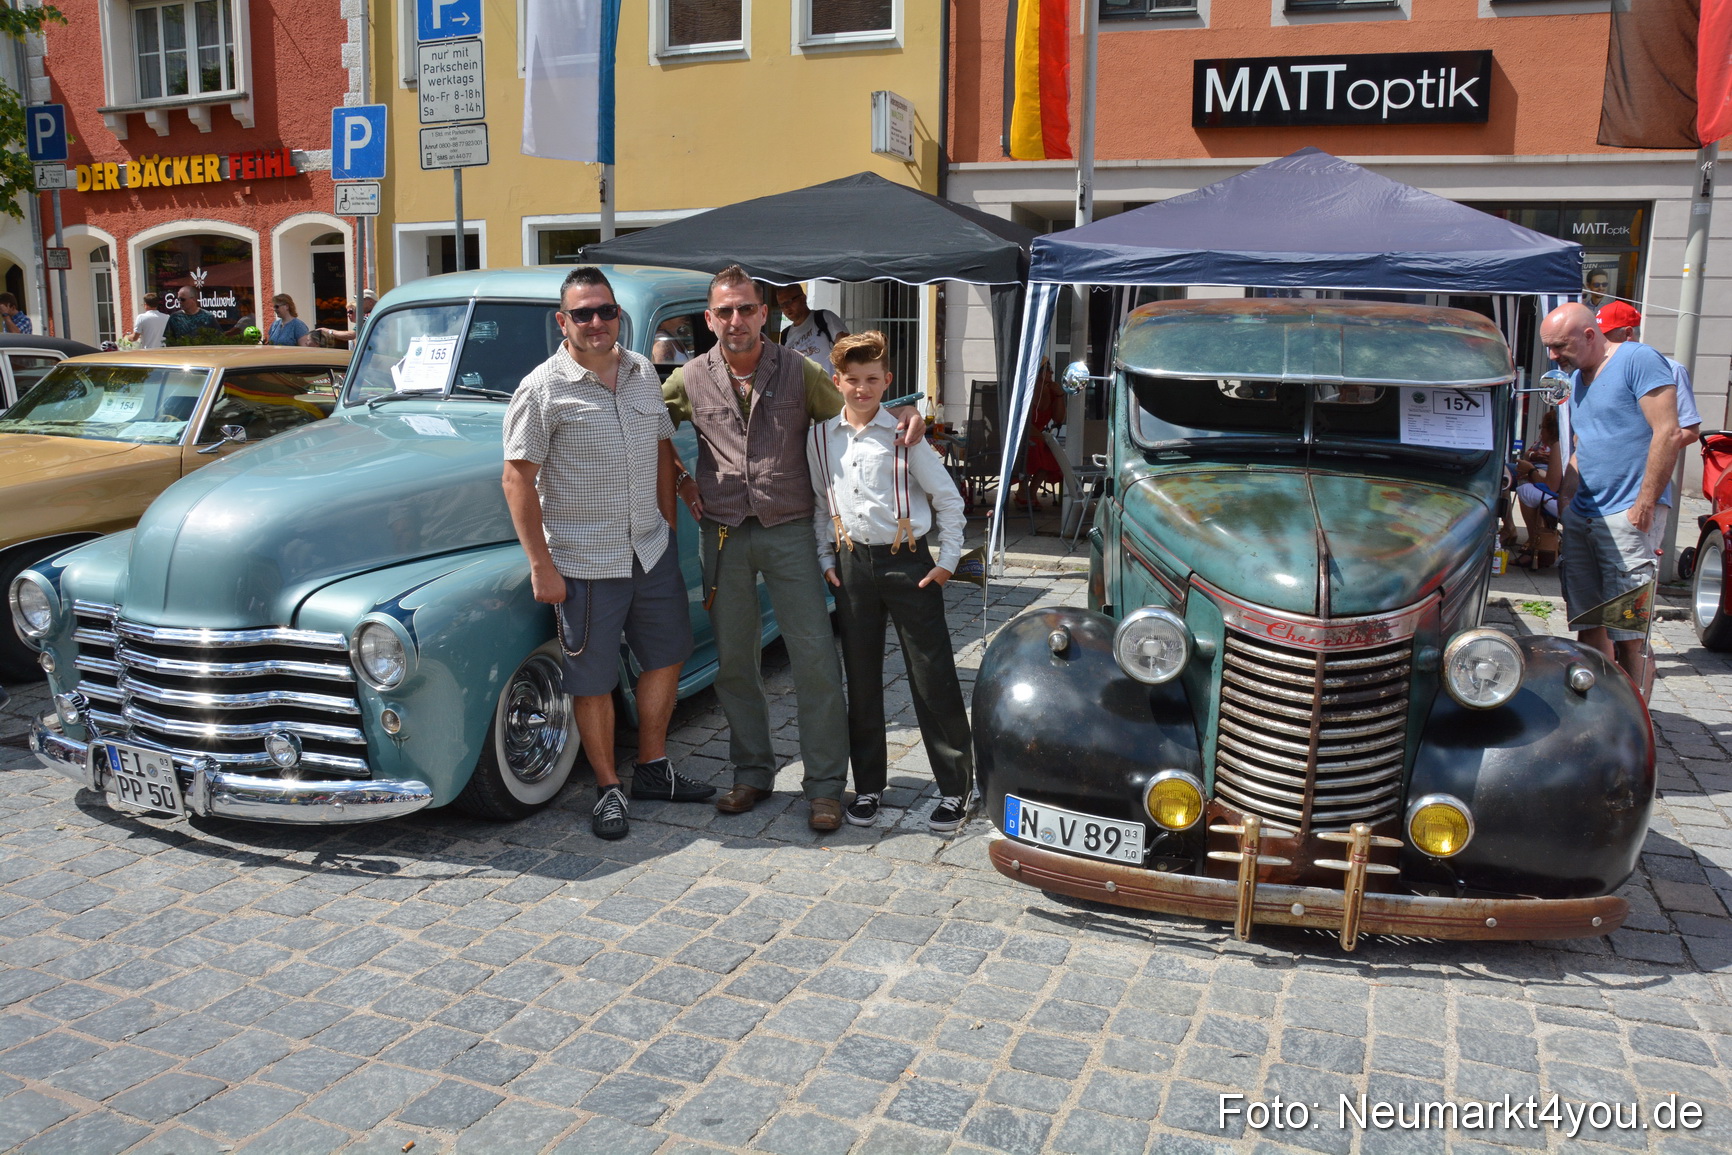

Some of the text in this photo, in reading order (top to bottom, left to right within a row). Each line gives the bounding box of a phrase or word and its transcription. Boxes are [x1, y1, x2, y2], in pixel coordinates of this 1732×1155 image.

[431, 47, 469, 61] nur mit
[423, 60, 478, 74] Parkschein
[428, 75, 474, 86] werktags
[423, 107, 434, 116] Sa
[35, 113, 56, 154] P
[344, 116, 372, 170] P
[76, 162, 121, 192] DER
[126, 153, 222, 188] BÄCKER
[430, 348, 447, 360] 155
[119, 402, 134, 410] 154
[1443, 396, 1476, 411] 157
[117, 749, 146, 778] EI
[117, 774, 176, 810] PP 50
[1009, 820, 1016, 829] D
[1021, 806, 1121, 855] N V 89
